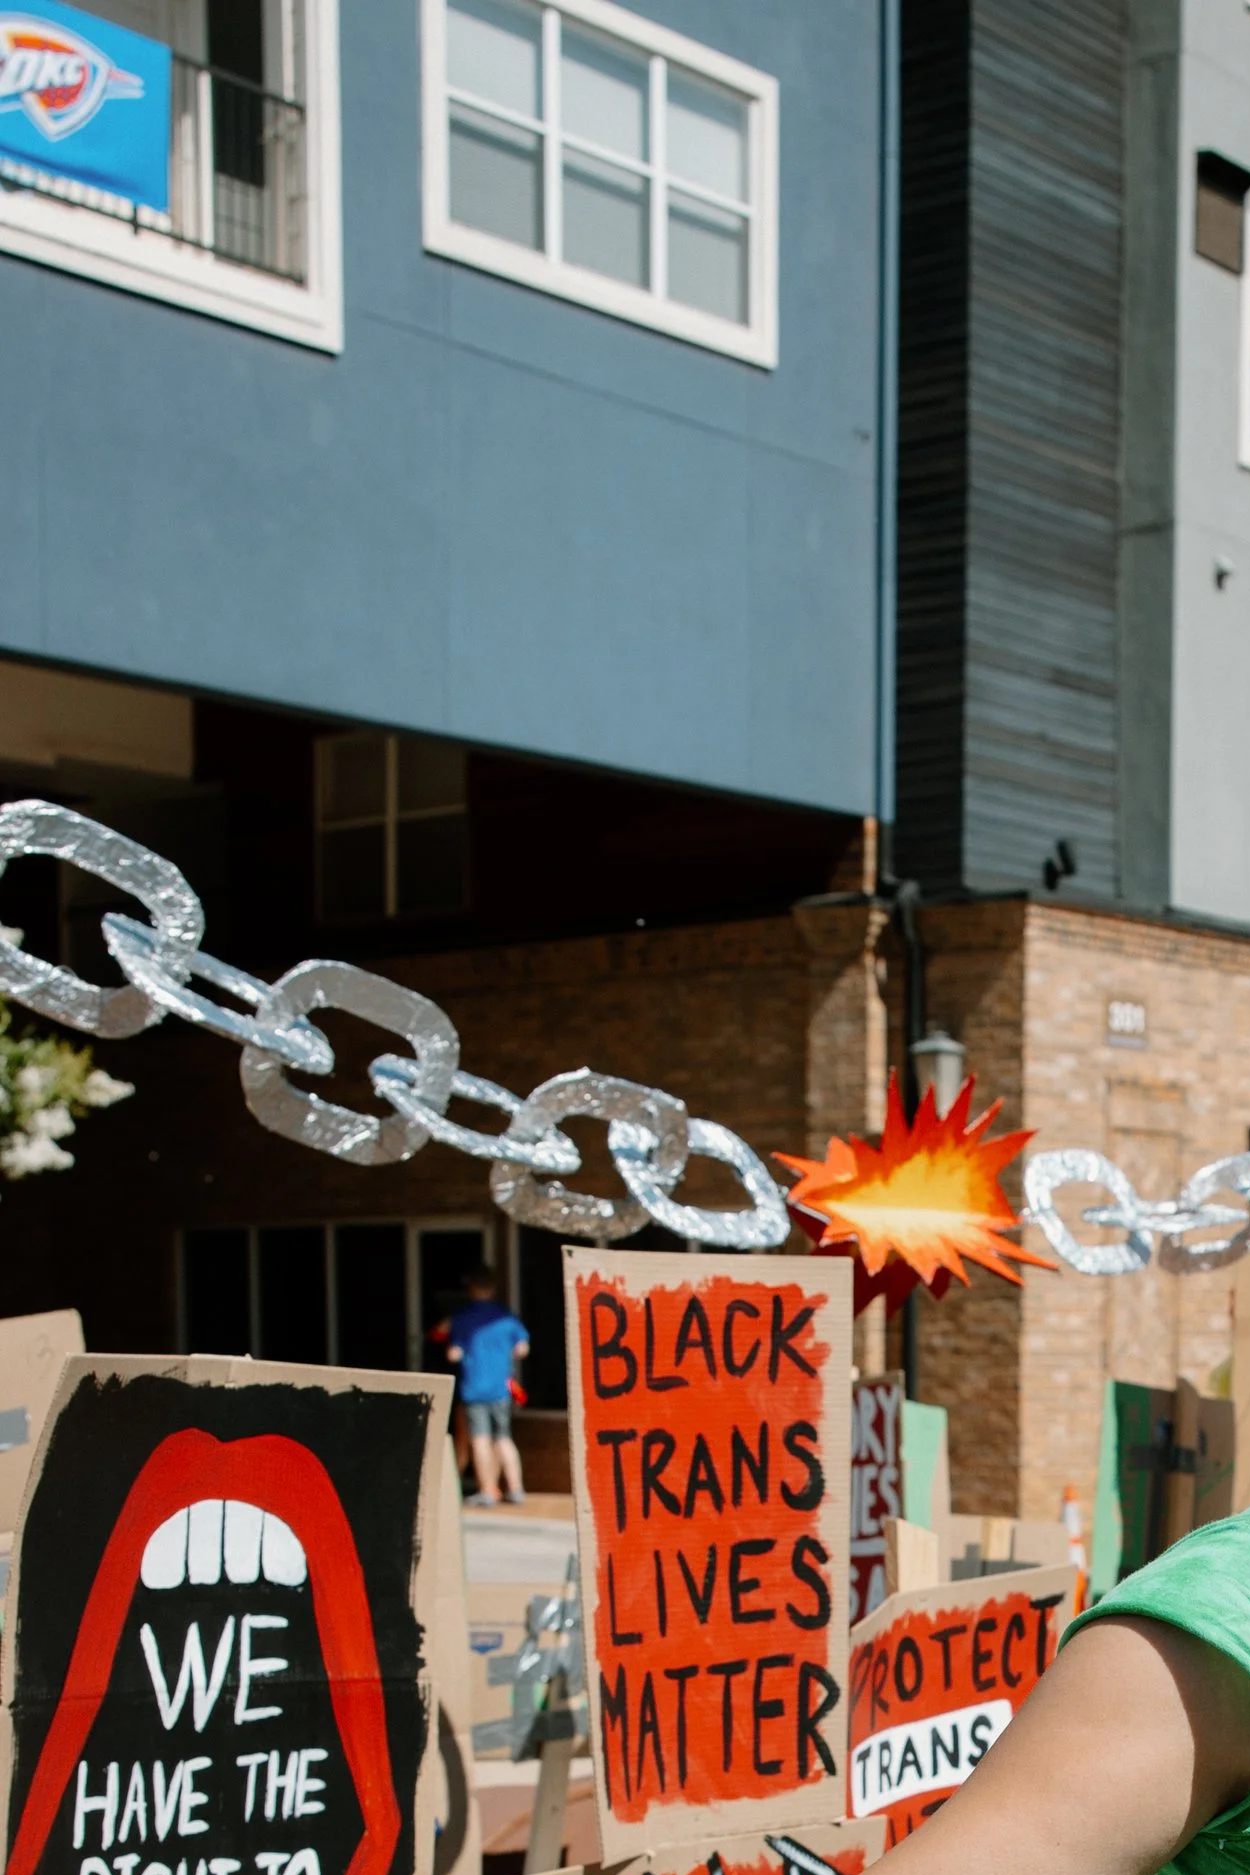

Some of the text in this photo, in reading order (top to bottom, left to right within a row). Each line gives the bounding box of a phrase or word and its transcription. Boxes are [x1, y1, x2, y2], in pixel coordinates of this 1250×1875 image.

[587, 1293, 816, 1400] BLACK
[597, 1419, 825, 1533] TRANS
[606, 1536, 831, 1647] LIVES
[140, 1612, 289, 1733] WE
[849, 1593, 1067, 1729] PROTECT
[600, 1653, 840, 1801] MATTER
[856, 1714, 994, 1802] TRANS
[73, 1747, 328, 1851] HAVE THE
